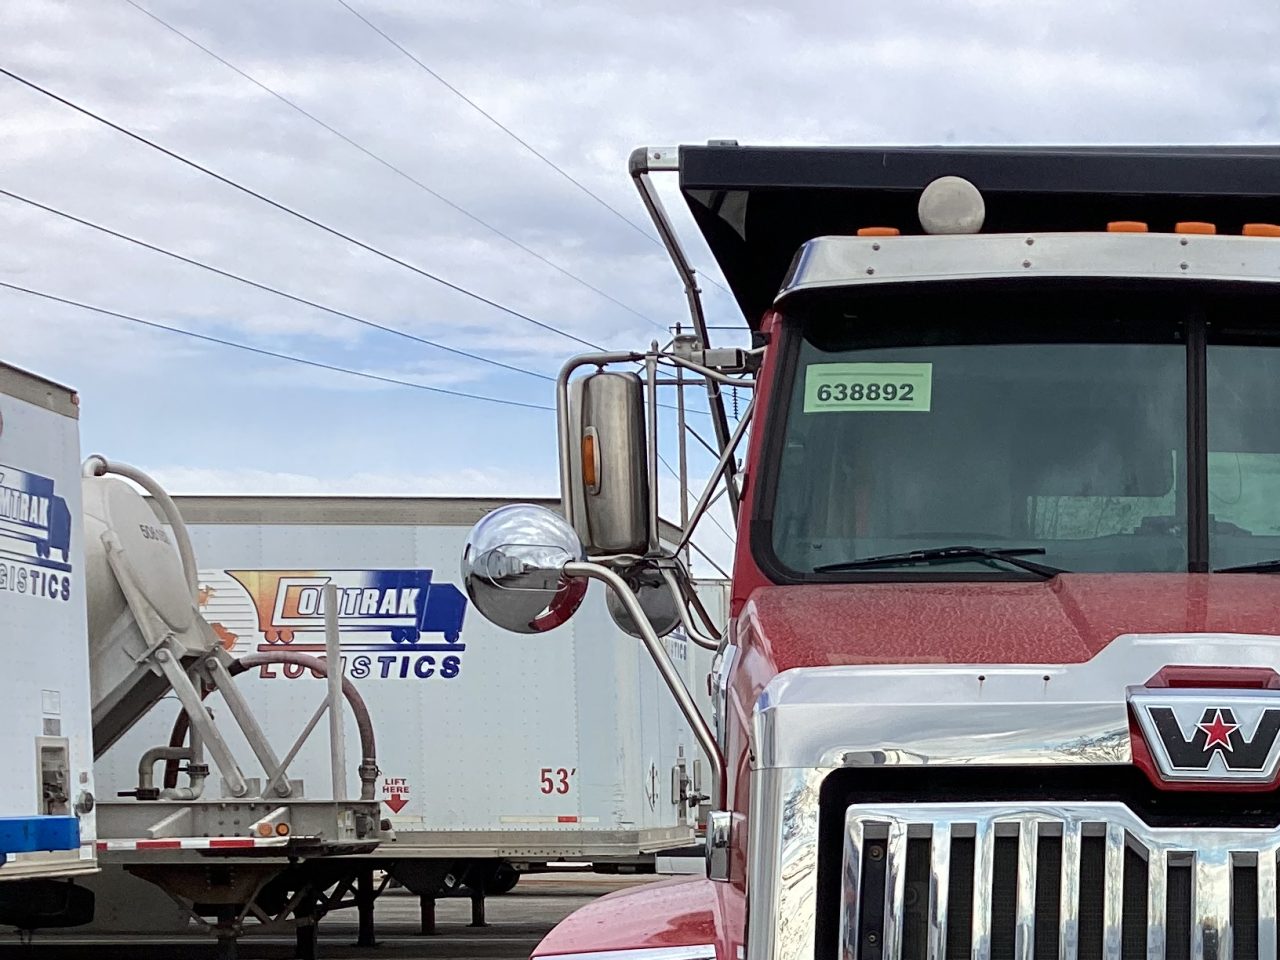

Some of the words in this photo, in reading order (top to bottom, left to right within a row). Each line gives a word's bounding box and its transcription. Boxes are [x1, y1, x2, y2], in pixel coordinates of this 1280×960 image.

[817, 383, 914, 401] 638892
[259, 655, 461, 679] LOSTICS
[385, 778, 407, 786] LIFT
[382, 786, 410, 794] HERE
